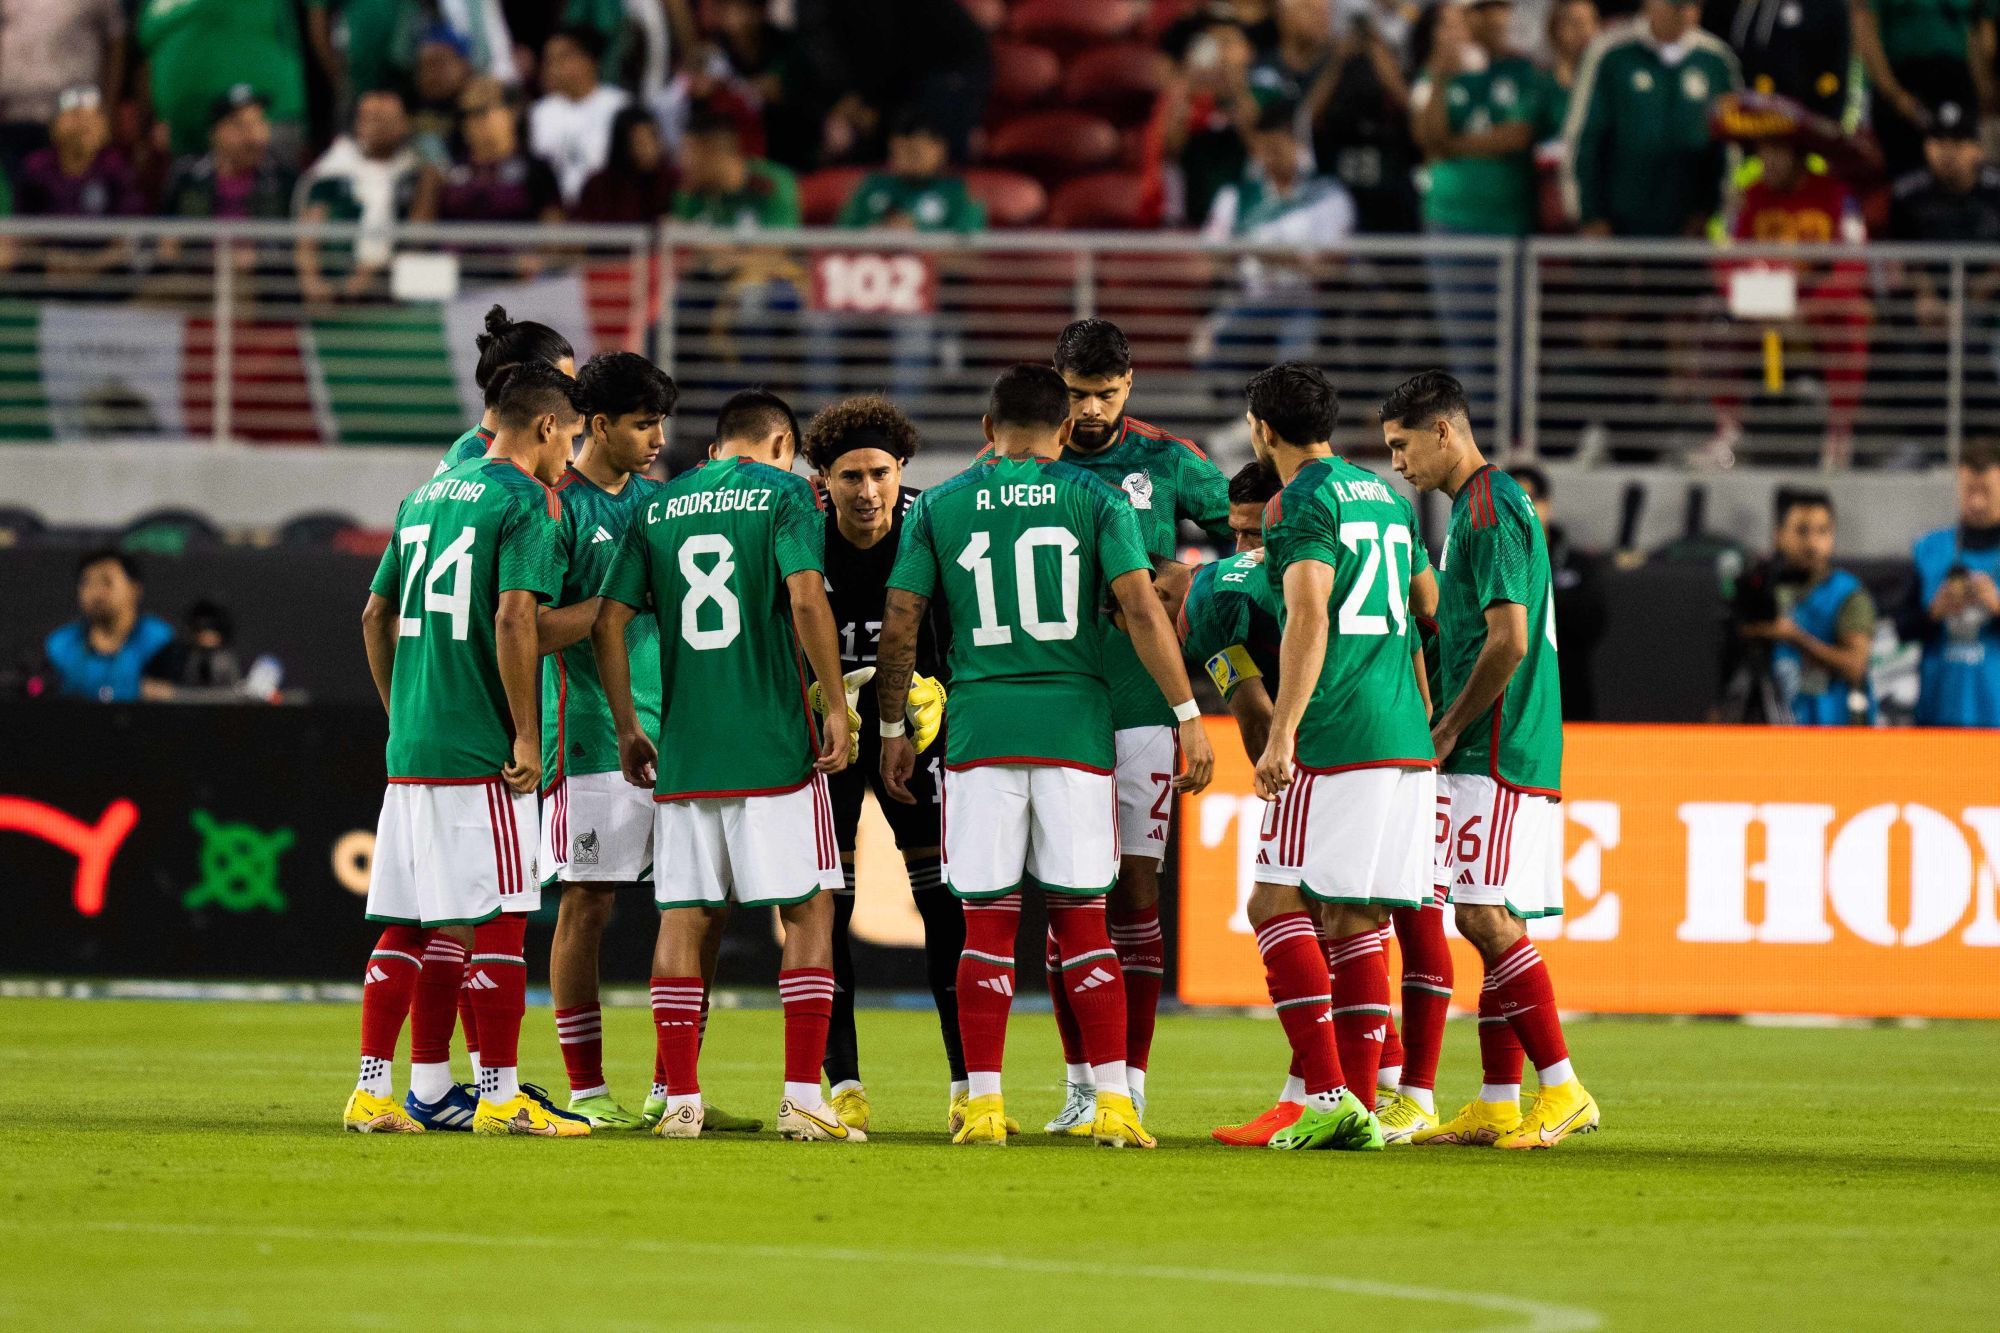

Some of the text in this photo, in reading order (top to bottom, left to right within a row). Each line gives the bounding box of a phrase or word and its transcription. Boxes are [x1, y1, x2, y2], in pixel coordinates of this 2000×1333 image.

[823, 255, 925, 312] 102
[665, 487, 772, 519] RODRÍGUEZ
[1000, 483, 1056, 507] VEGA
[678, 533, 741, 650] 8
[956, 526, 1080, 646] 10
[1339, 521, 1413, 636] 20
[1150, 772, 1171, 821] 2
[1457, 815, 1482, 862] 6
[1677, 801, 2000, 946] HO
